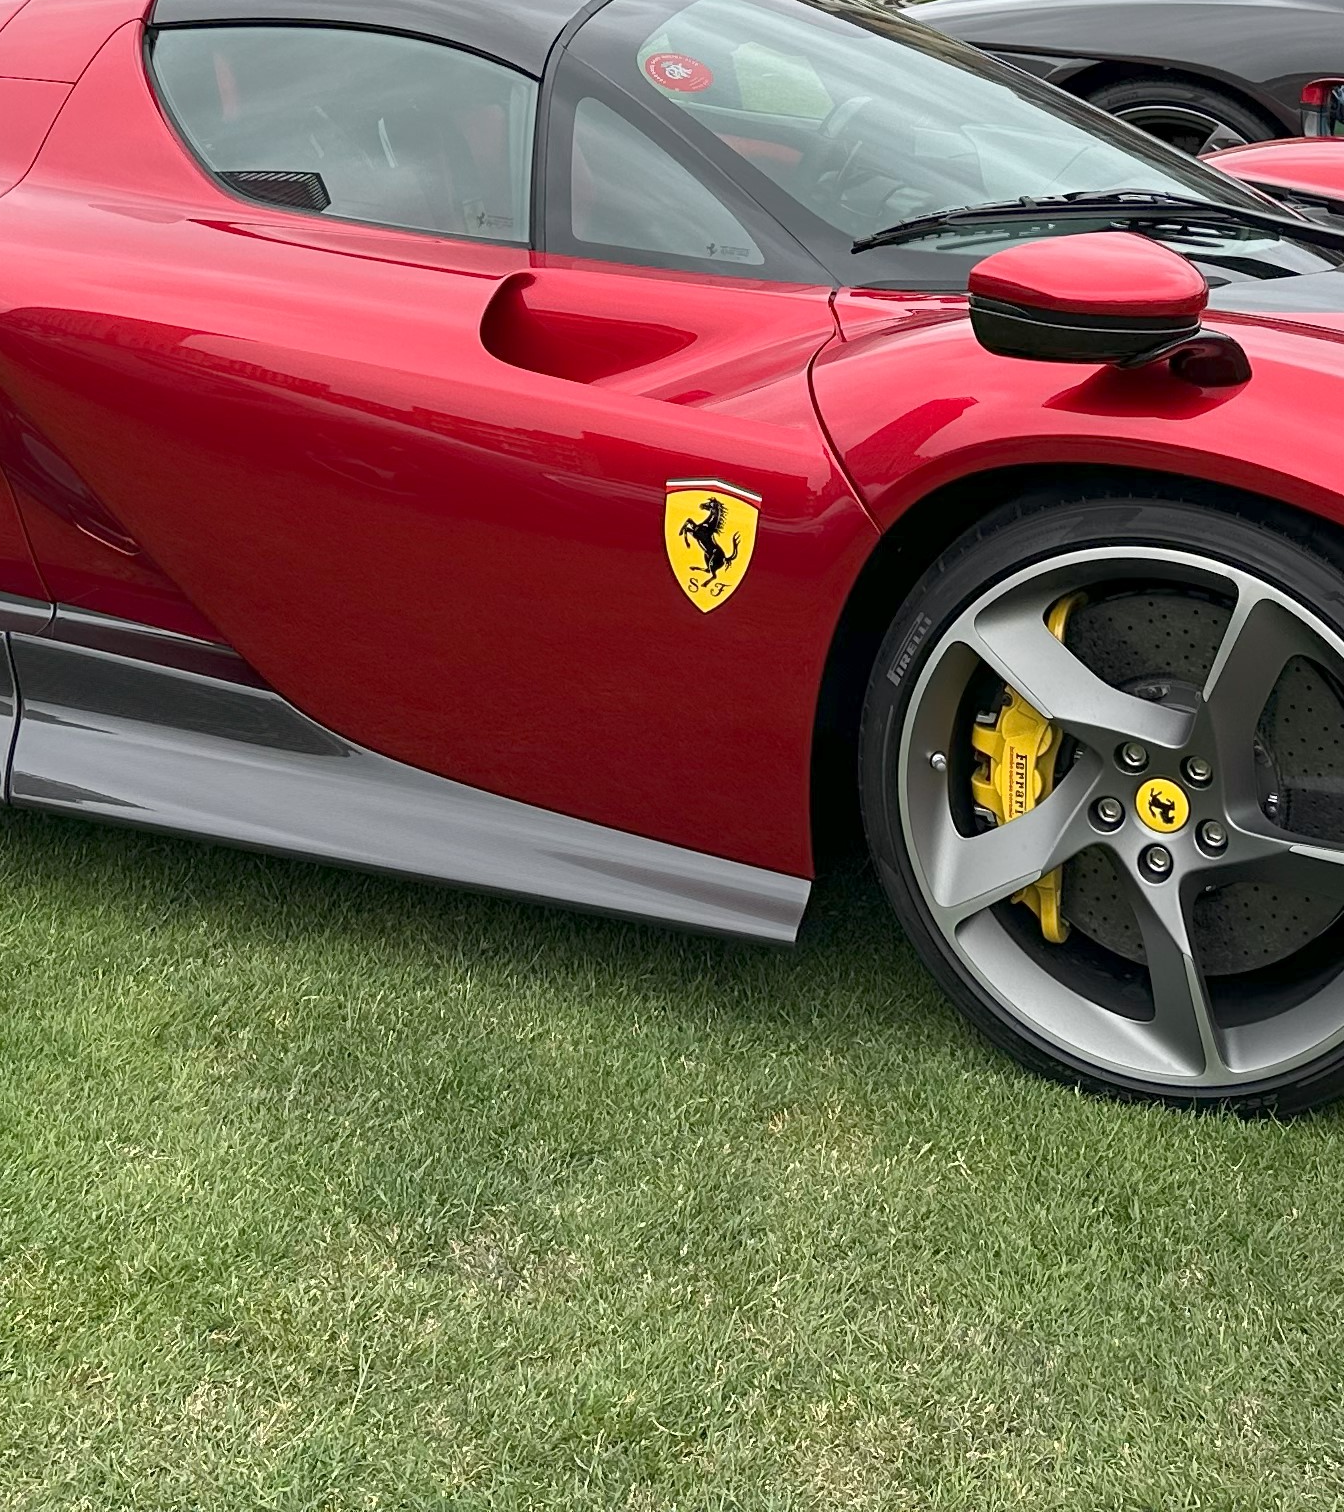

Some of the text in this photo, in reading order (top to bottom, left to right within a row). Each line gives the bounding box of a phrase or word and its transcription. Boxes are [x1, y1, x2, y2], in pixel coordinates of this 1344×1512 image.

[688, 577, 732, 597] S F
[886, 611, 932, 687] PIRELLI
[1015, 752, 1028, 816] Ferrari
